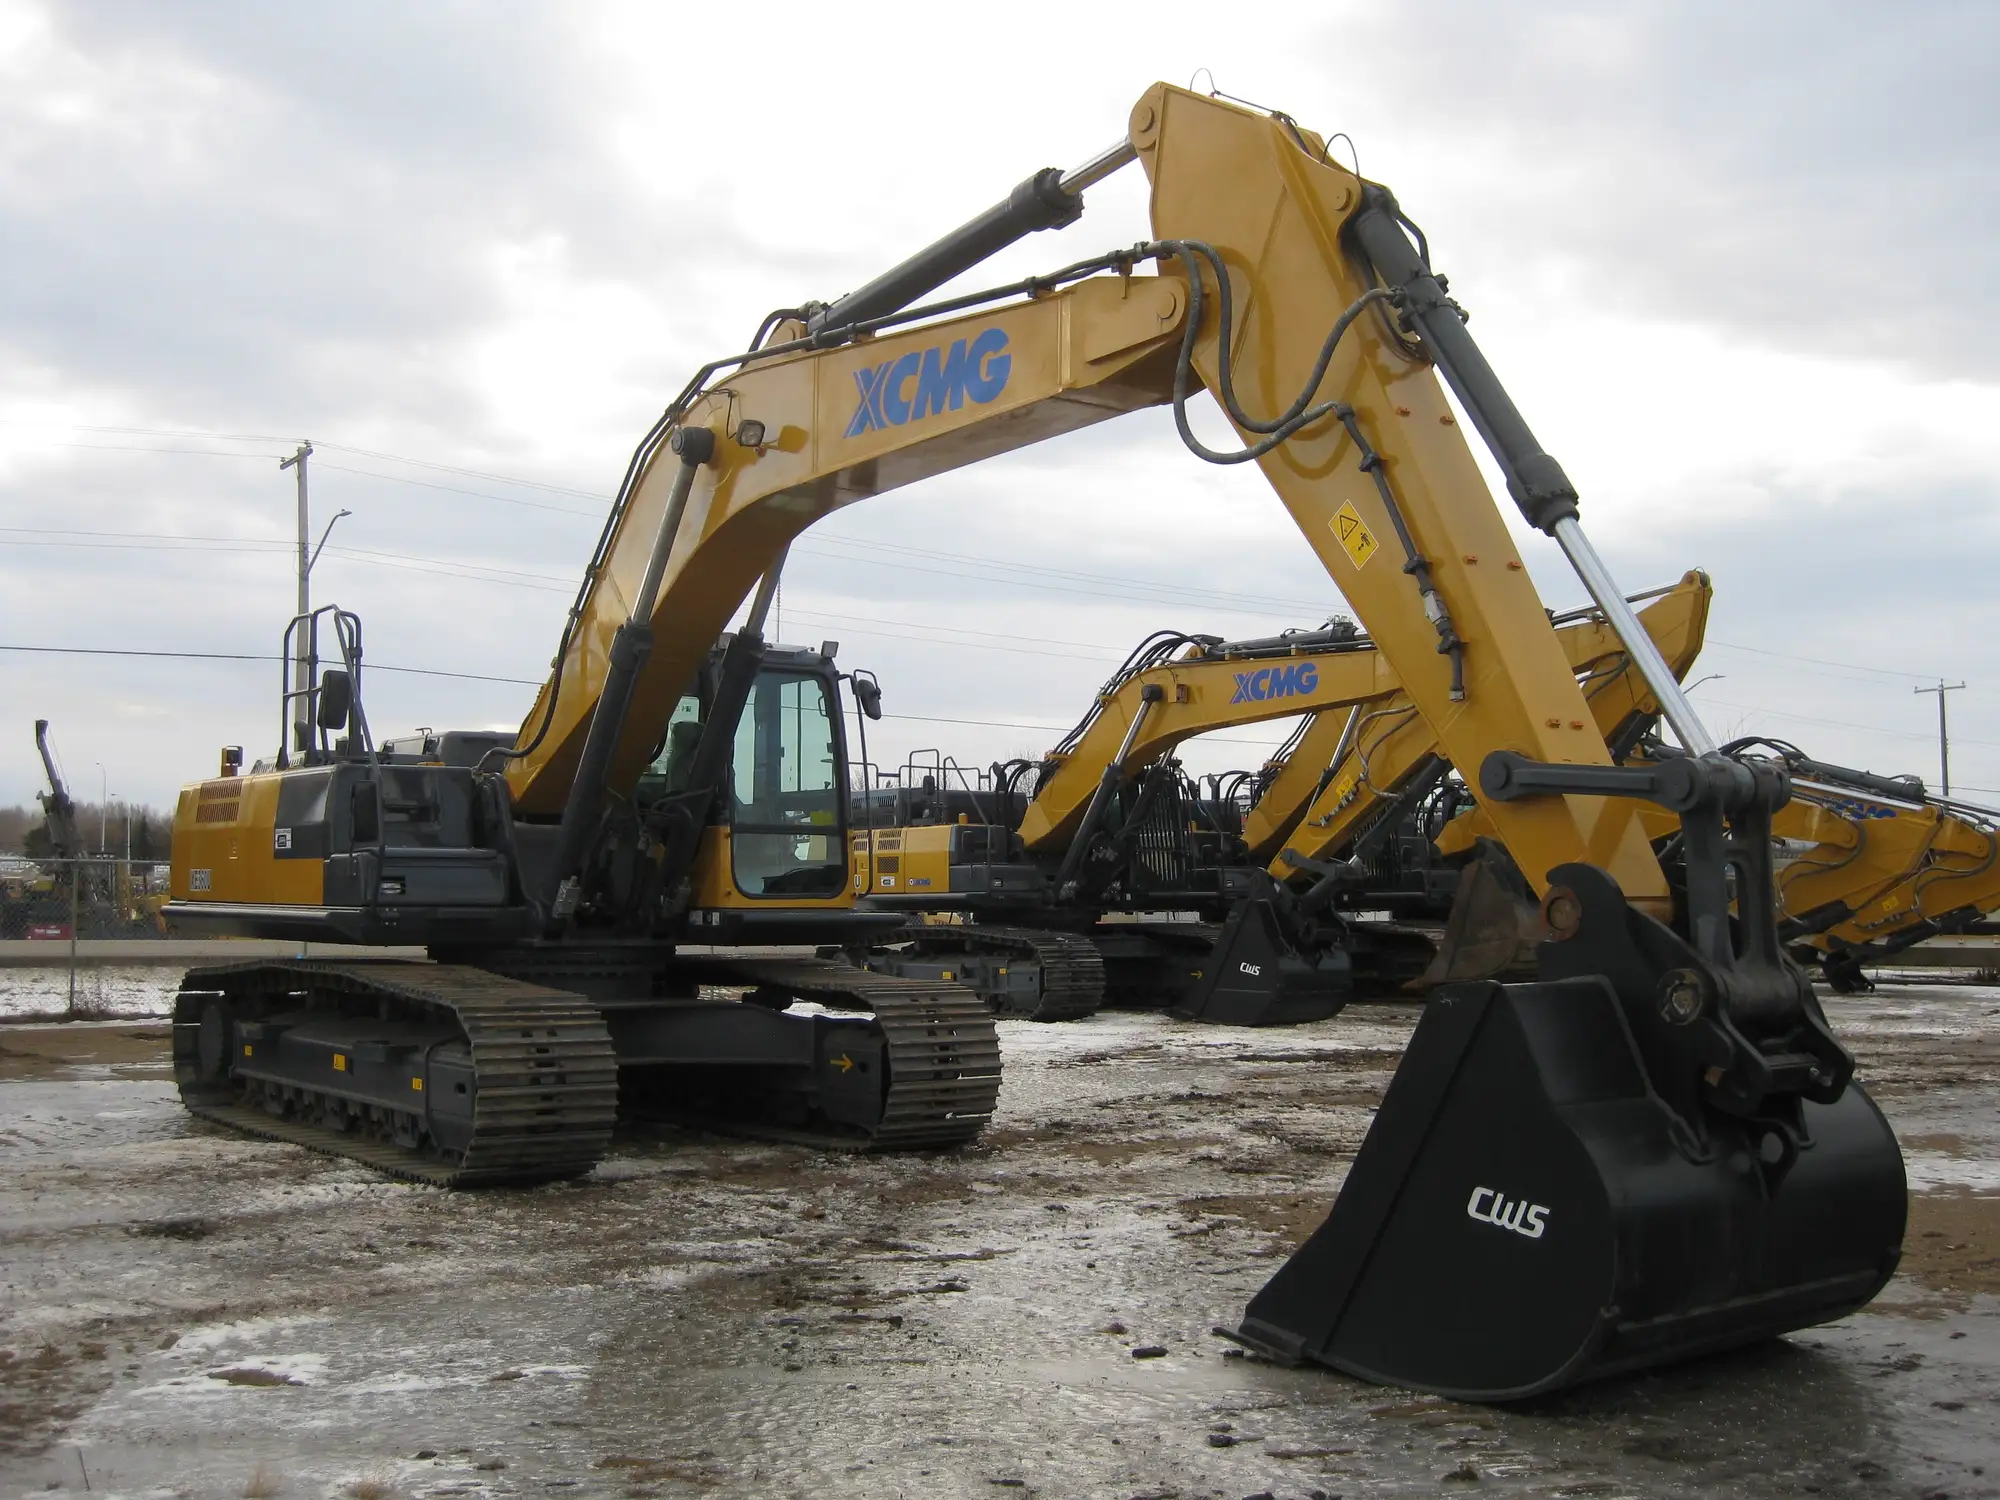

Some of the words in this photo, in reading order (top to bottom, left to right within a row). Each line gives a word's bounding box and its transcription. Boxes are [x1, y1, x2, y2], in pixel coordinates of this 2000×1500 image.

[843, 328, 1012, 439] XCMG
[1229, 662, 1319, 705] XCMG
[1240, 962, 1261, 976] CWS
[1467, 1186, 1550, 1238] CWS
